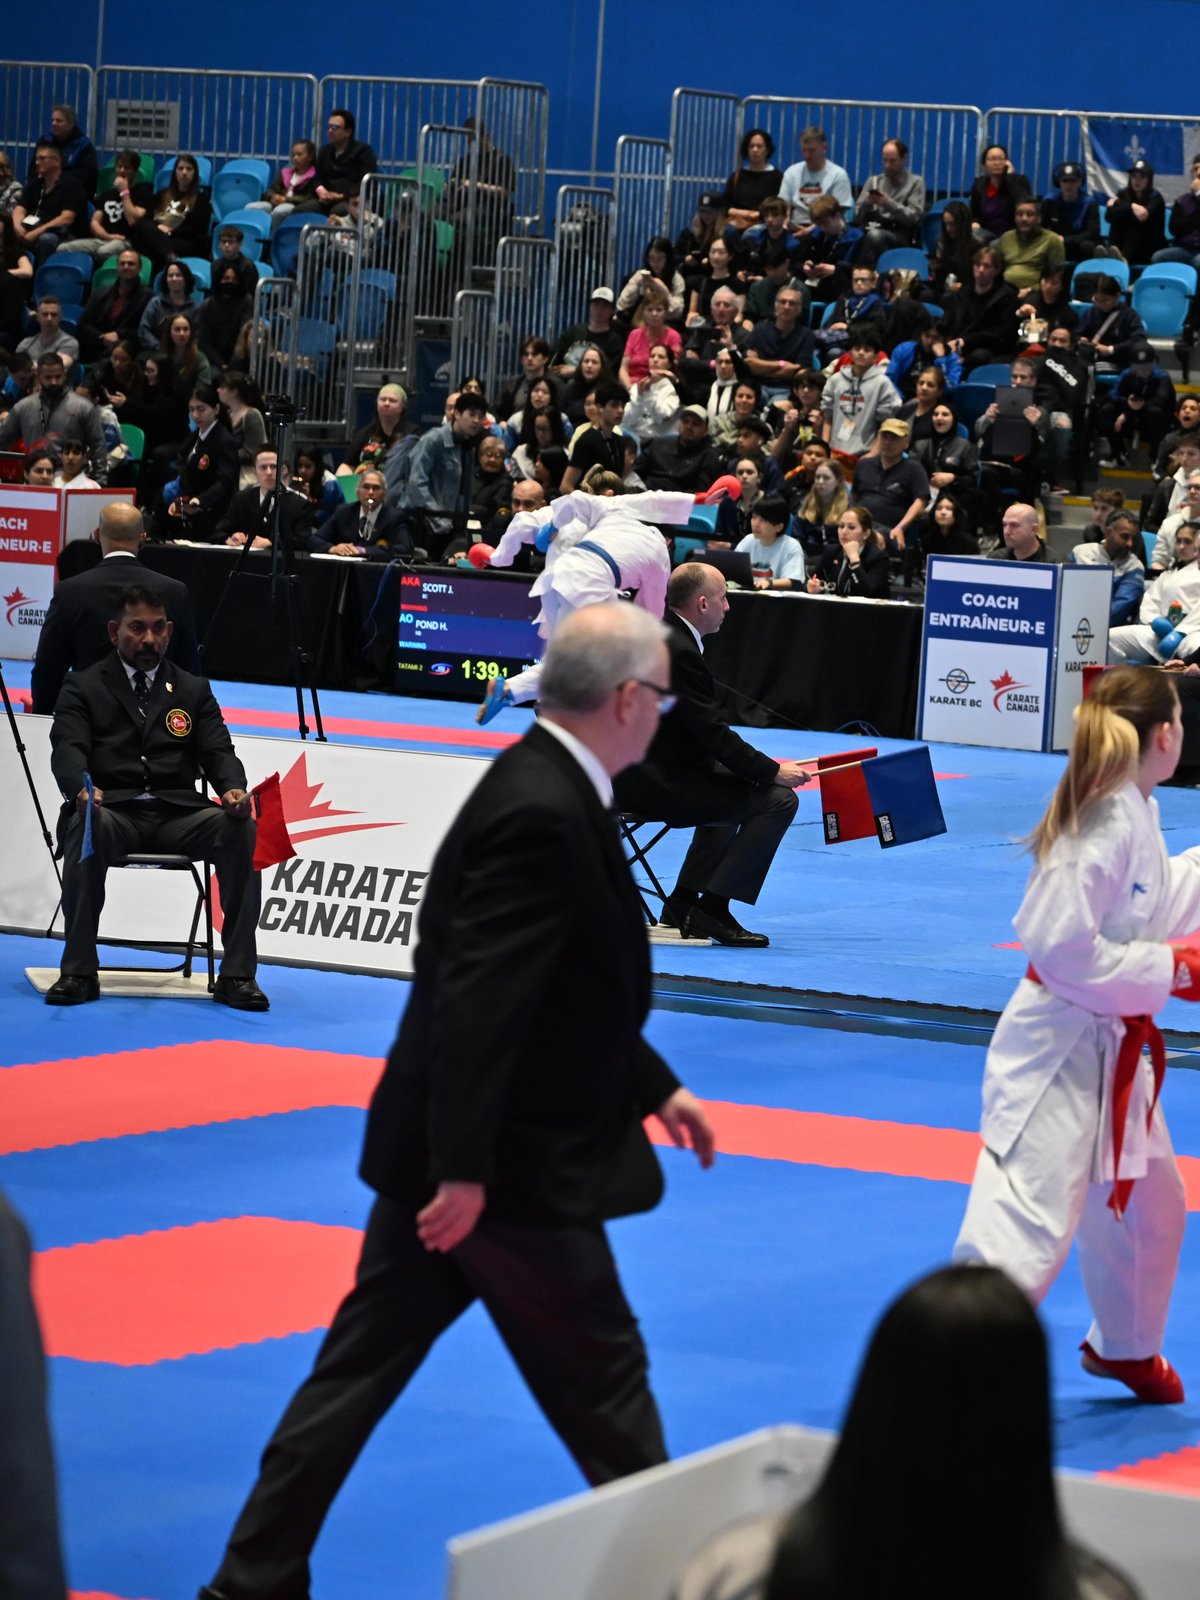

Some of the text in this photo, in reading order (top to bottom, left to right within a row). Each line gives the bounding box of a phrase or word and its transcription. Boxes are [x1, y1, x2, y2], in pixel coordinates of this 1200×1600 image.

[1045, 358, 1078, 387] adidas
[0, 516, 28, 530] ACH
[0, 538, 52, 553] NEUR·E
[401, 576, 420, 587] AKA
[422, 582, 454, 594] SCOTT J.
[961, 592, 1019, 610] COACH
[18, 616, 44, 626] CANAD
[399, 613, 414, 624] AO
[929, 612, 1045, 635] ENTRAÎNEUR·E
[415, 619, 448, 631] POND H.
[398, 662, 418, 671] TATAMI
[929, 695, 982, 708] KARATE BC
[1006, 693, 1040, 705] KARATE
[1006, 702, 1040, 714] CANADA
[270, 858, 430, 906] KARATE
[258, 896, 413, 947] CANADA
